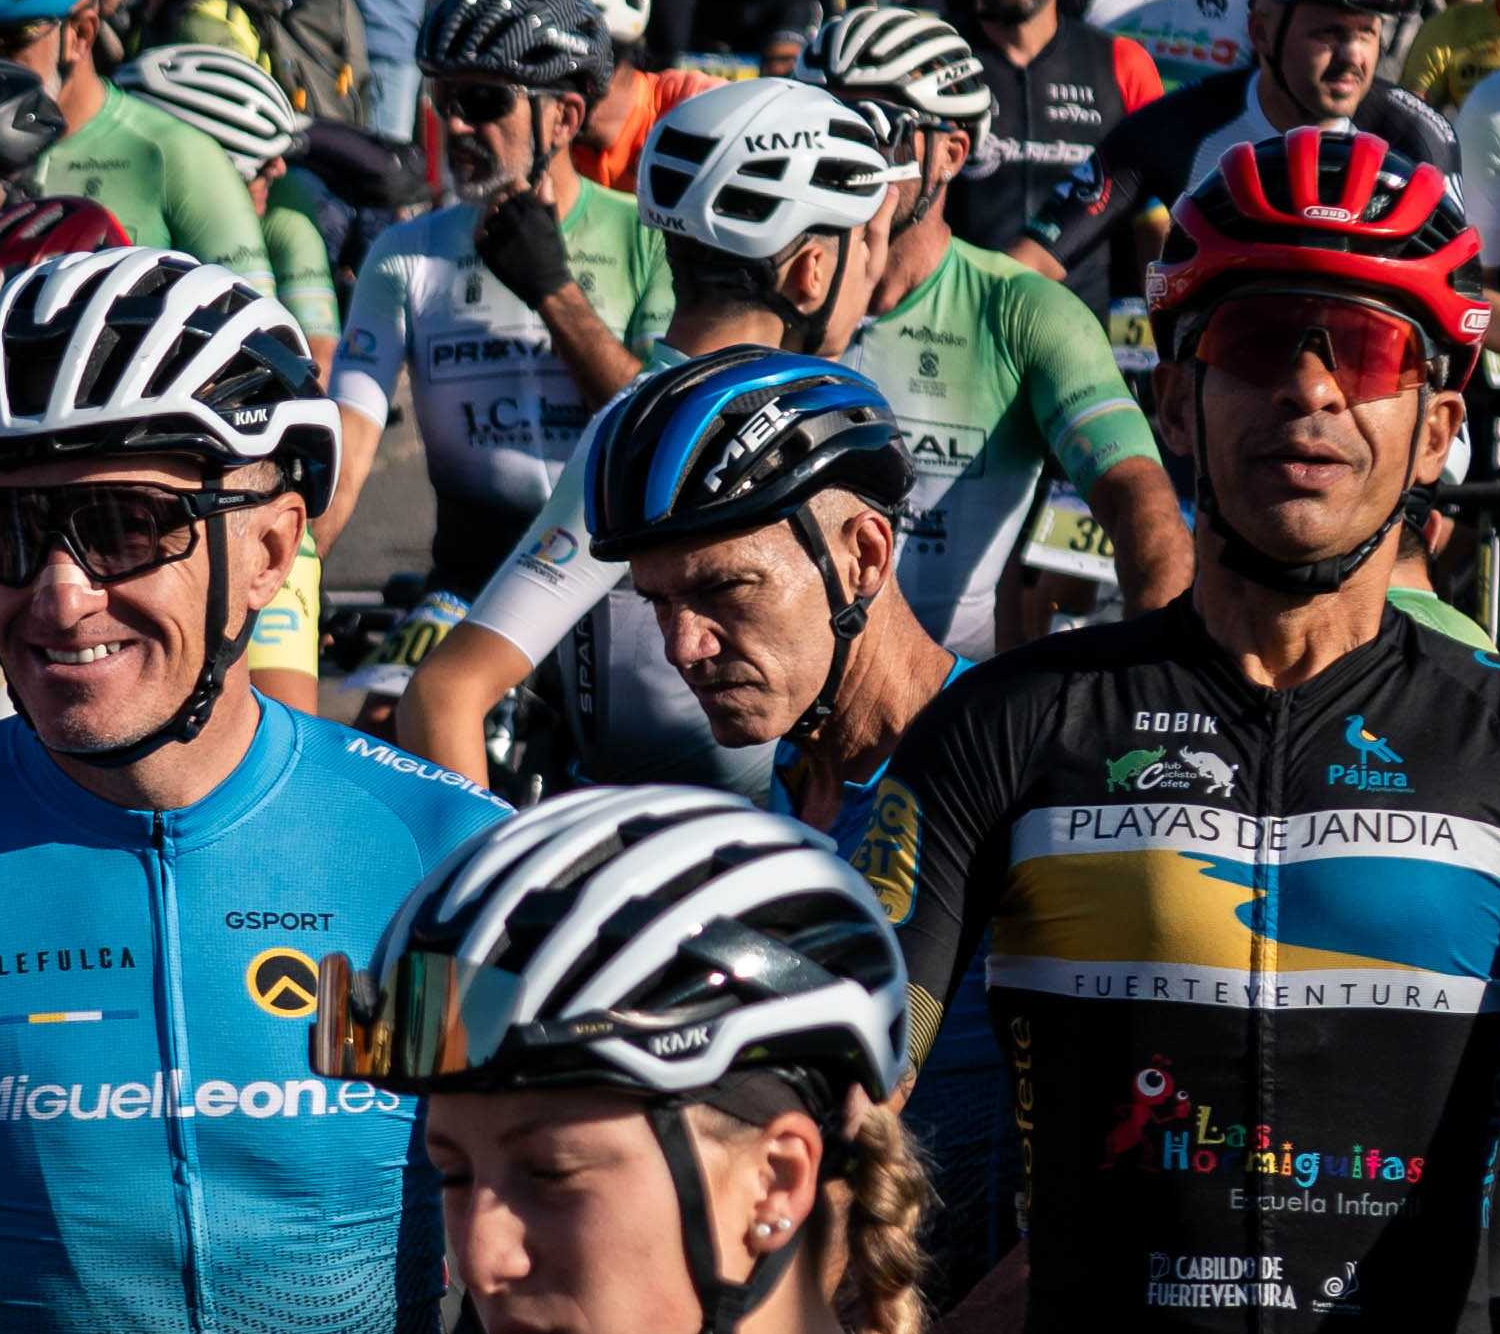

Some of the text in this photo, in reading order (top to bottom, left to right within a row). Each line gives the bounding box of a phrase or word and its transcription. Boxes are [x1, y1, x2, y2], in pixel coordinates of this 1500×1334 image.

[744, 129, 825, 154] KASK
[647, 209, 686, 232] KASK
[1308, 207, 1348, 220] ABUS
[235, 408, 269, 426] KASK
[703, 394, 804, 494] MET
[1133, 710, 1219, 735] GOBIK
[1327, 763, 1408, 793] Pájara
[1067, 805, 1460, 852] PLAYAS DE JANDIA
[225, 911, 334, 932] GSPORT
[1074, 973, 1452, 1012] FUERTEVENTURA
[651, 1023, 714, 1058] KASK
[1194, 1104, 1273, 1151] Las
[1162, 1129, 1426, 1188] Hormiguitas
[1229, 1187, 1327, 1214] Escuela
[1174, 1255, 1284, 1281] CABILDO DE
[1147, 1282, 1298, 1310] FUERTEVENTURA
